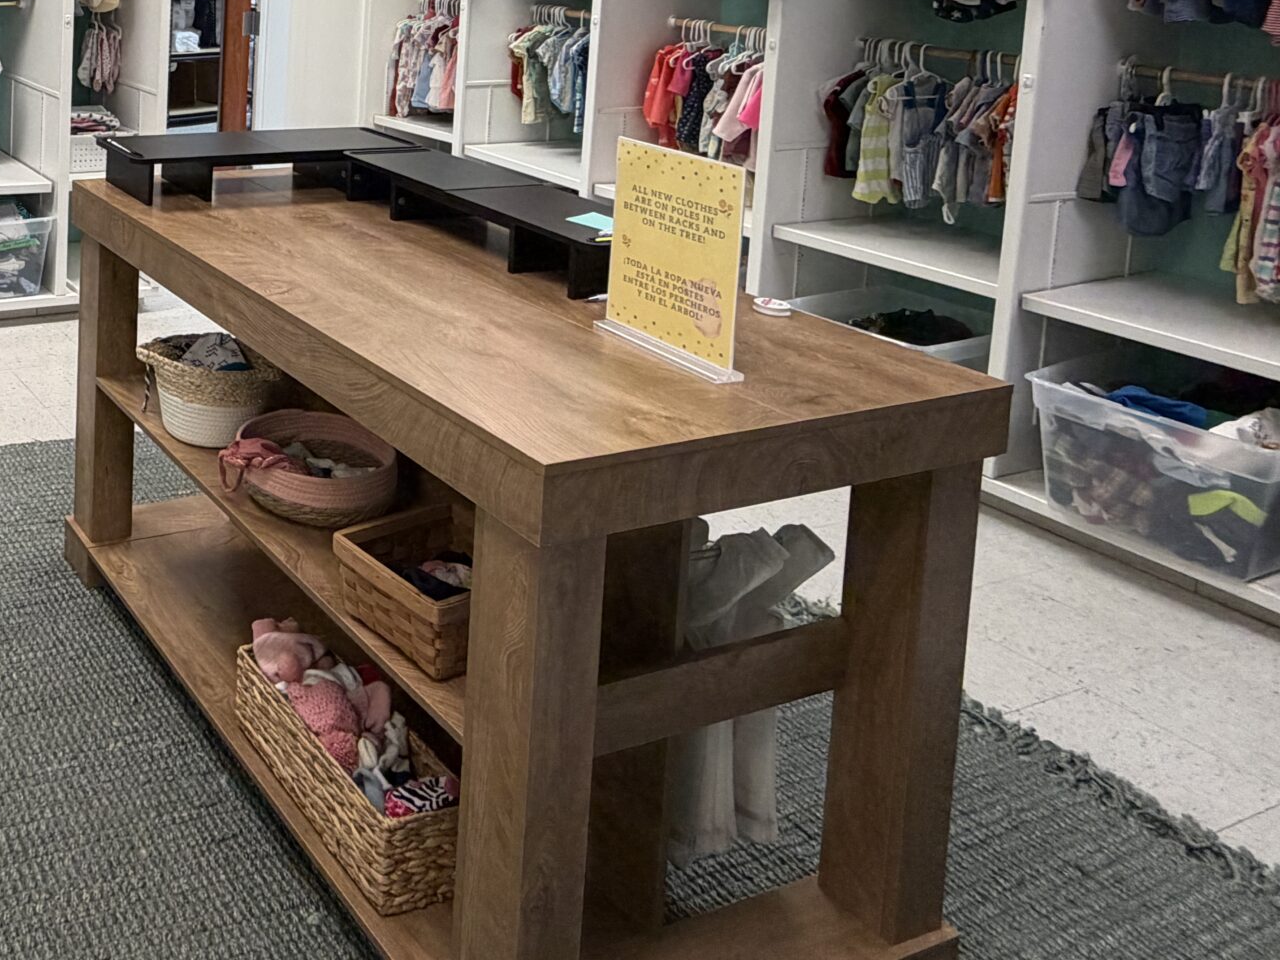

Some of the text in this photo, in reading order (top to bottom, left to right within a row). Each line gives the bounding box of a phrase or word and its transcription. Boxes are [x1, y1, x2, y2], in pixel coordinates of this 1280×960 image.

[632, 184, 719, 217] ALL NEW CLOTHES
[635, 195, 714, 225] ARE ON POLES IN
[624, 201, 726, 240] BETWEEN RACKS AND
[642, 217, 706, 244] ON THE TREE!
[623, 256, 722, 300] ¡TODA LA ROPA NUEVA
[659, 278, 669, 289] EN
[672, 283, 704, 302] POSTES
[623, 274, 721, 319] ENTRE LOS PERCHEROS
[645, 292, 656, 302] EN
[659, 297, 668, 307] EL
